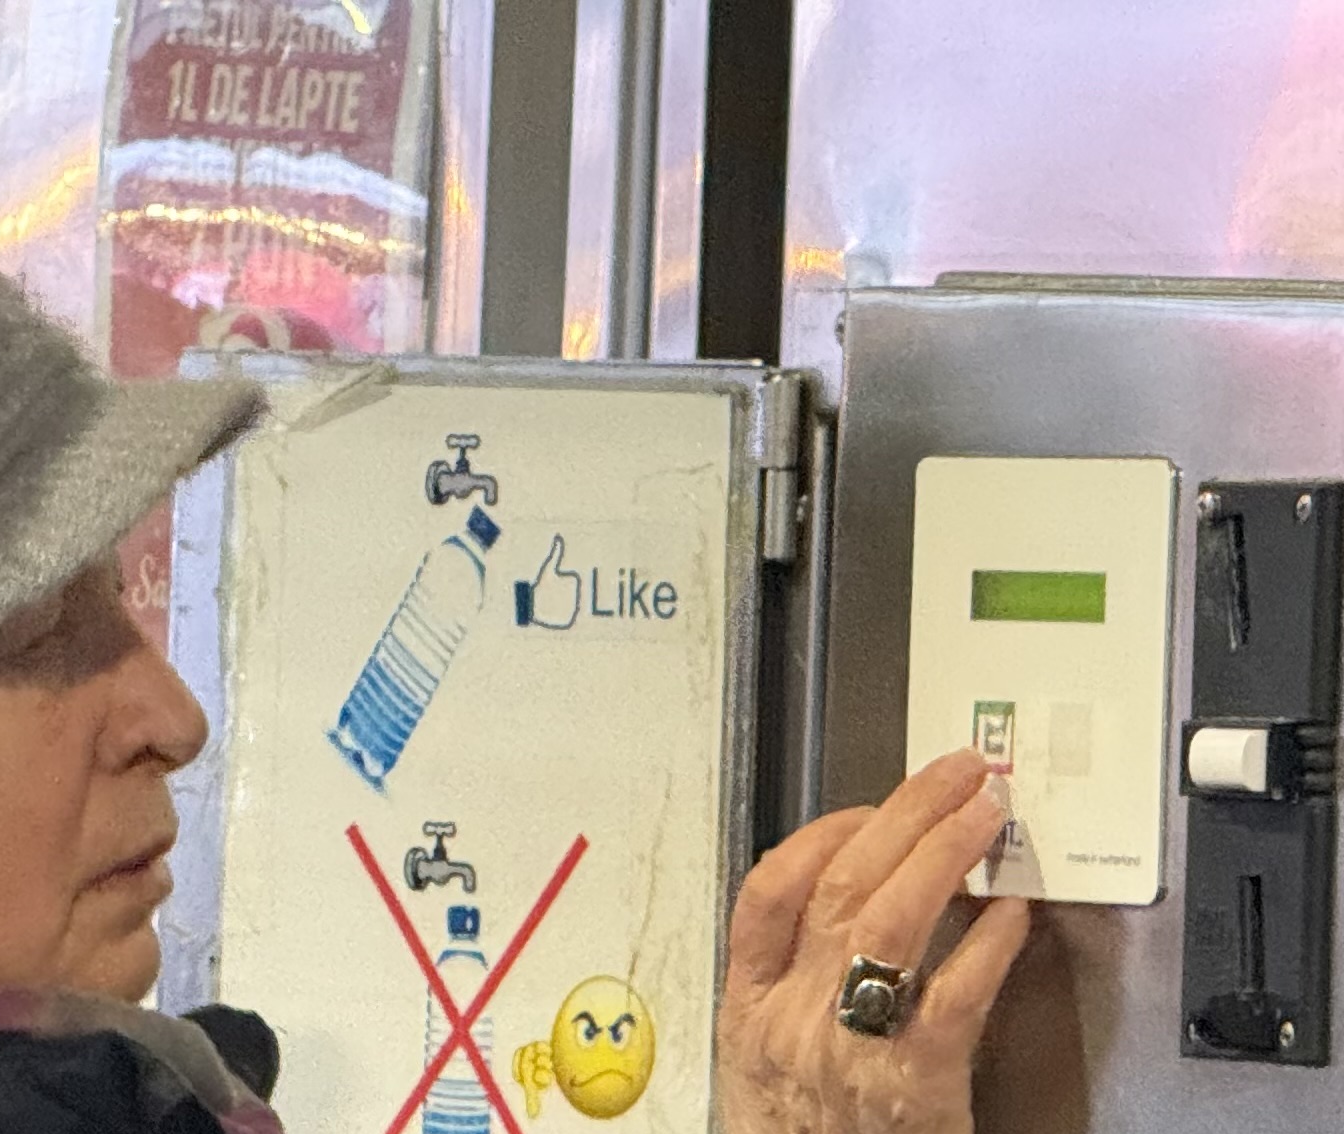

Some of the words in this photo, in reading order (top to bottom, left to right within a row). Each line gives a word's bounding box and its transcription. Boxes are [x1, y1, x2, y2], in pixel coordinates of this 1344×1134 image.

[167, 59, 199, 122] 1L
[208, 62, 253, 125] DE
[258, 65, 366, 134] LAPTE
[590, 567, 679, 620] Like
